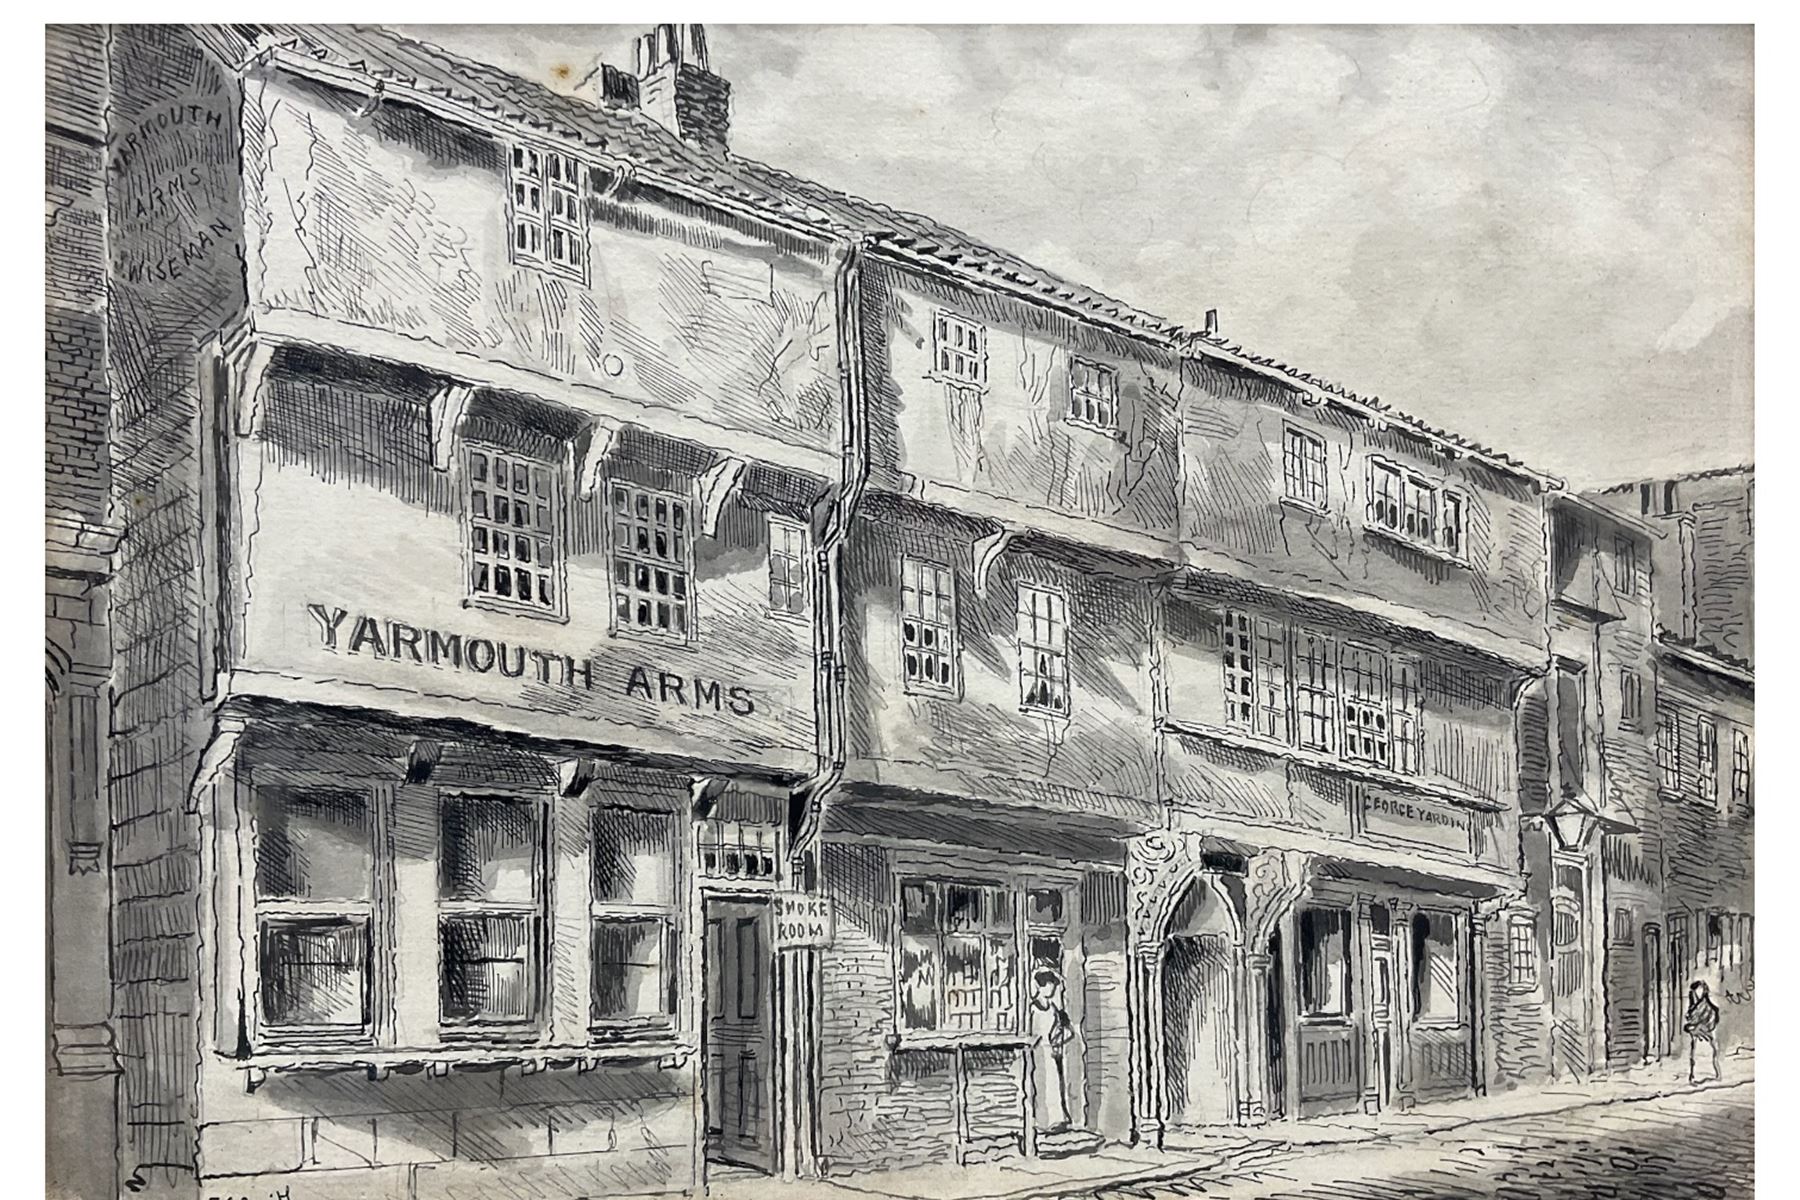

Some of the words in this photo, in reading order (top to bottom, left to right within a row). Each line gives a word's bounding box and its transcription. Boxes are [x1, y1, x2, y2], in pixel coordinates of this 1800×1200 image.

[109, 104, 222, 177] YARMOUTH
[136, 167, 201, 218] ARMS
[307, 603, 595, 691] YARMOUTH
[625, 666, 756, 717] ARMS
[1364, 795, 1414, 819] GEORGE
[774, 898, 828, 918] SMOKE
[777, 922, 823, 940] ROOM
